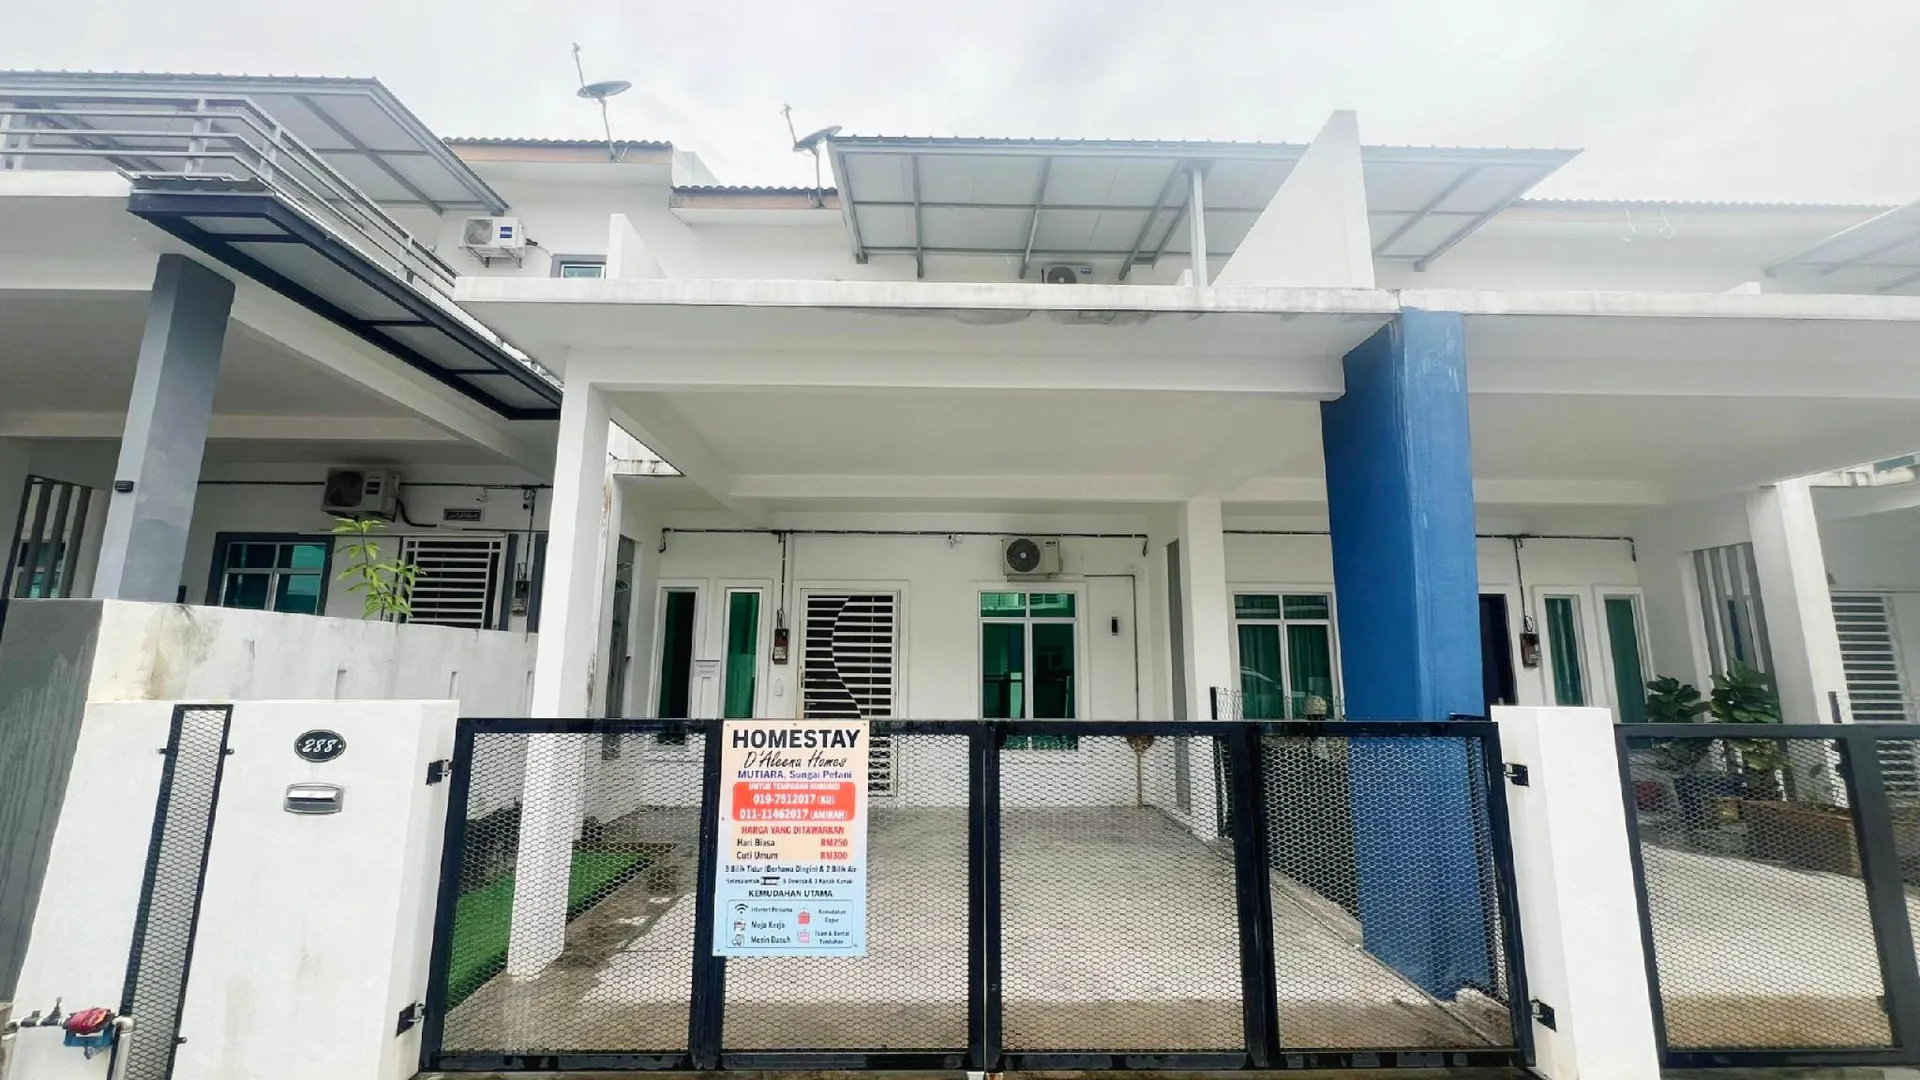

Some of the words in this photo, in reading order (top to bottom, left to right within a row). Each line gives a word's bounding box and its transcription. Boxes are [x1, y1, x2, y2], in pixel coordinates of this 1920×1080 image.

[732, 729, 861, 748] HOMESTAY
[302, 738, 338, 753] 288
[743, 750, 802, 769] D'Aleena
[807, 749, 848, 768] Homes
[737, 770, 787, 780] MUTIARA,
[789, 770, 821, 781] Sungai
[822, 770, 853, 779] Petani
[739, 808, 809, 820] 011-11462017
[810, 810, 848, 820] (AMIRAH)
[741, 826, 769, 835] HARGA
[770, 826, 792, 835] YANG
[793, 826, 845, 835] DITAWARKAN
[736, 838, 753, 847] Hari
[754, 838, 776, 847] Biasa
[820, 838, 848, 847] RM250
[736, 851, 752, 860] Cuti
[754, 851, 779, 860] Umum
[820, 851, 848, 860] RM300
[747, 865, 764, 873] Tidur
[748, 890, 802, 898] KEMUDAHAN
[751, 921, 768, 930] Meja
